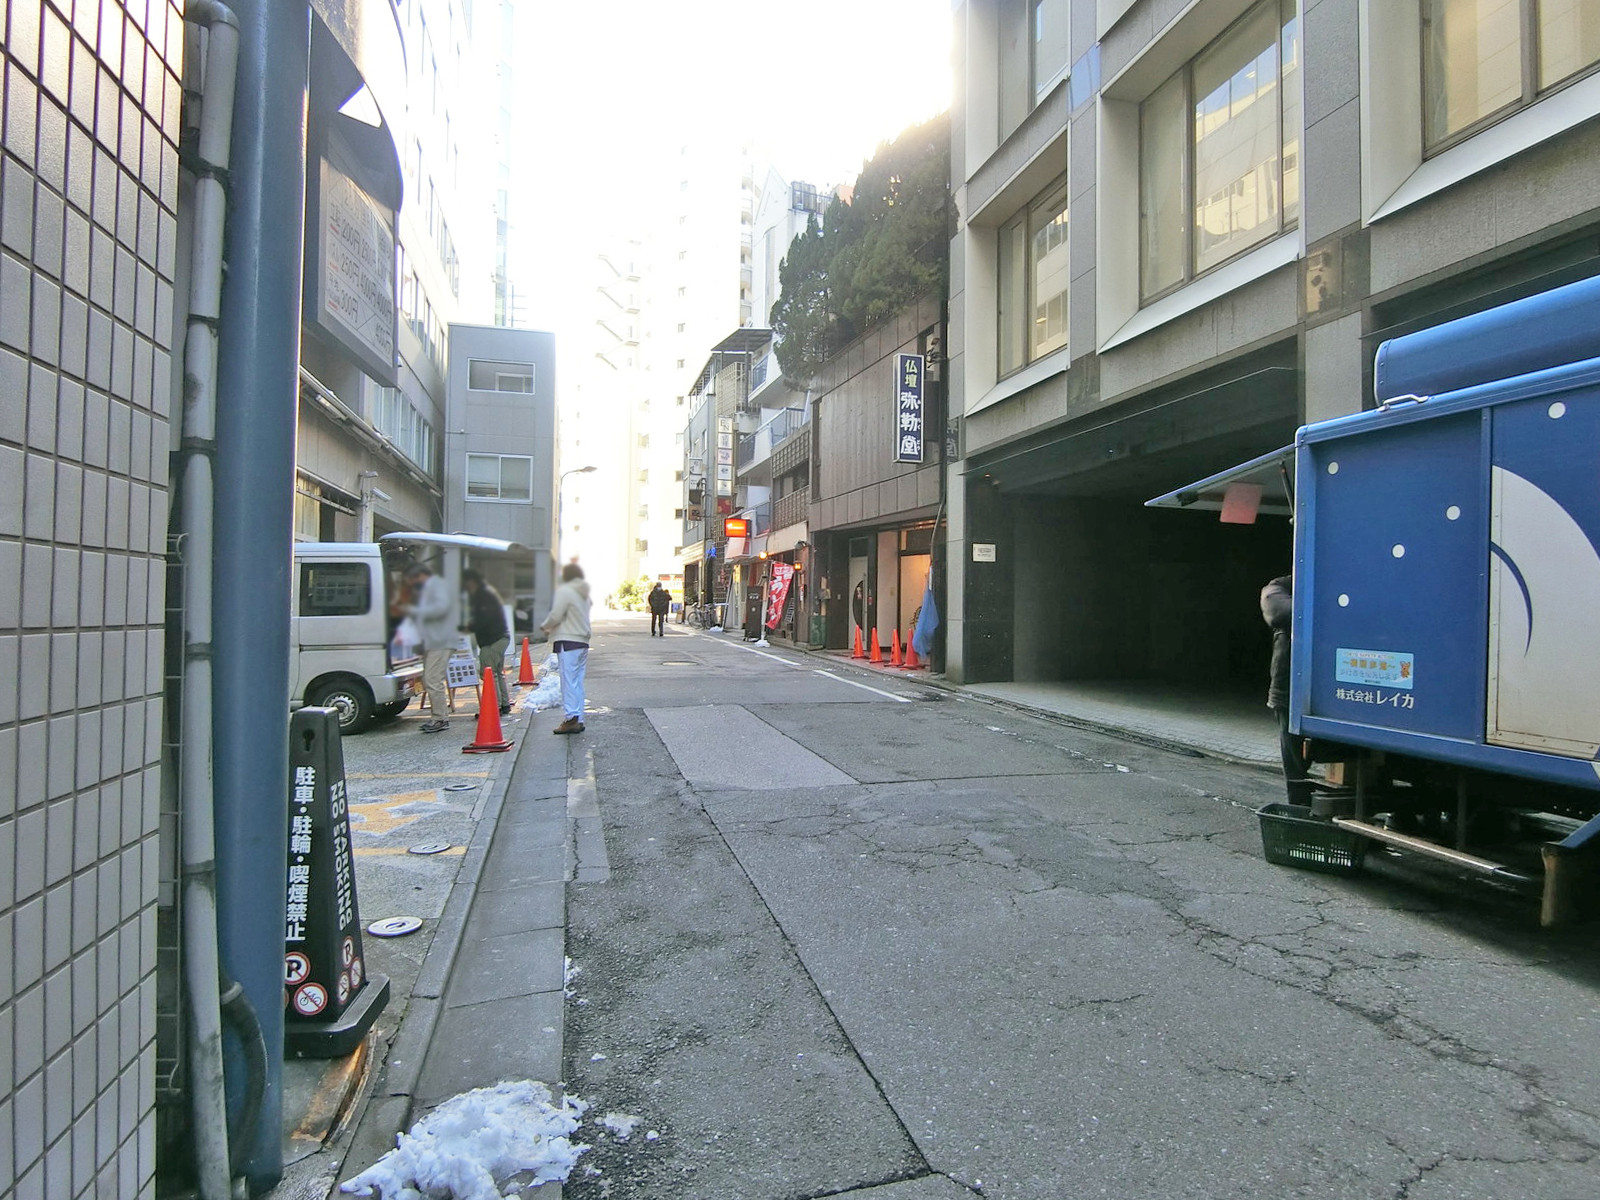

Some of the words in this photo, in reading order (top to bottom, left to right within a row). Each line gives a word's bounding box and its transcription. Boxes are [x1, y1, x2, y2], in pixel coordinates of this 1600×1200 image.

[904, 359, 918, 388] 仏壇
[900, 391, 919, 455] 弥勒堂
[1336, 688, 1415, 709] 株式会社レイカ
[331, 783, 339, 819] NO
[337, 780, 345, 815] NO
[286, 766, 316, 941] 駐車・駐輪・喫煙禁止
[333, 825, 346, 931] SMOKING
[340, 821, 353, 925] PARKING
